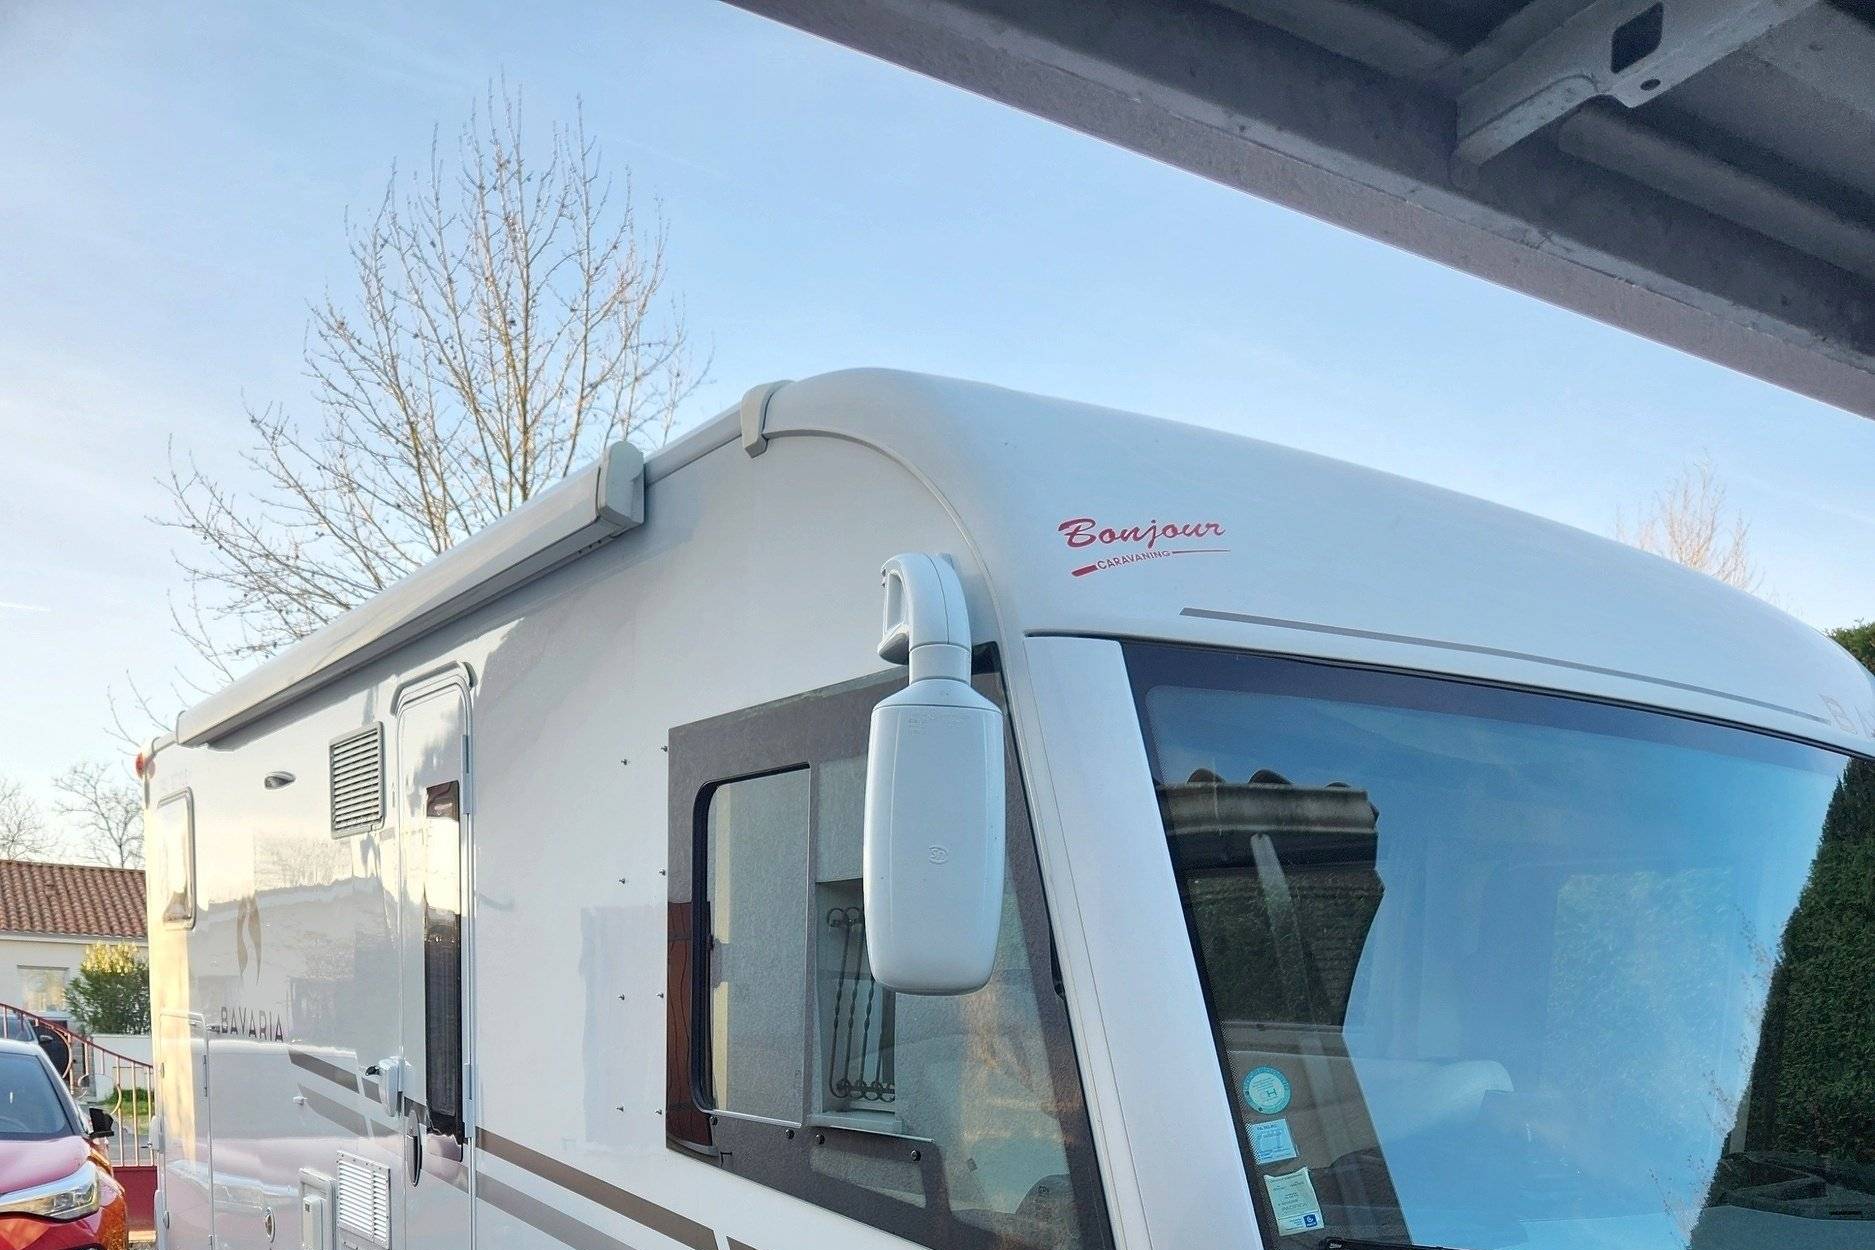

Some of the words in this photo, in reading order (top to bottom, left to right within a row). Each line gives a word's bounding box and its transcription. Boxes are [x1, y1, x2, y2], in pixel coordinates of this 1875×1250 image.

[1057, 518, 1226, 549] Bonjour
[1096, 550, 1171, 570] CARAVANING
[220, 1006, 284, 1042] BAVARIA
